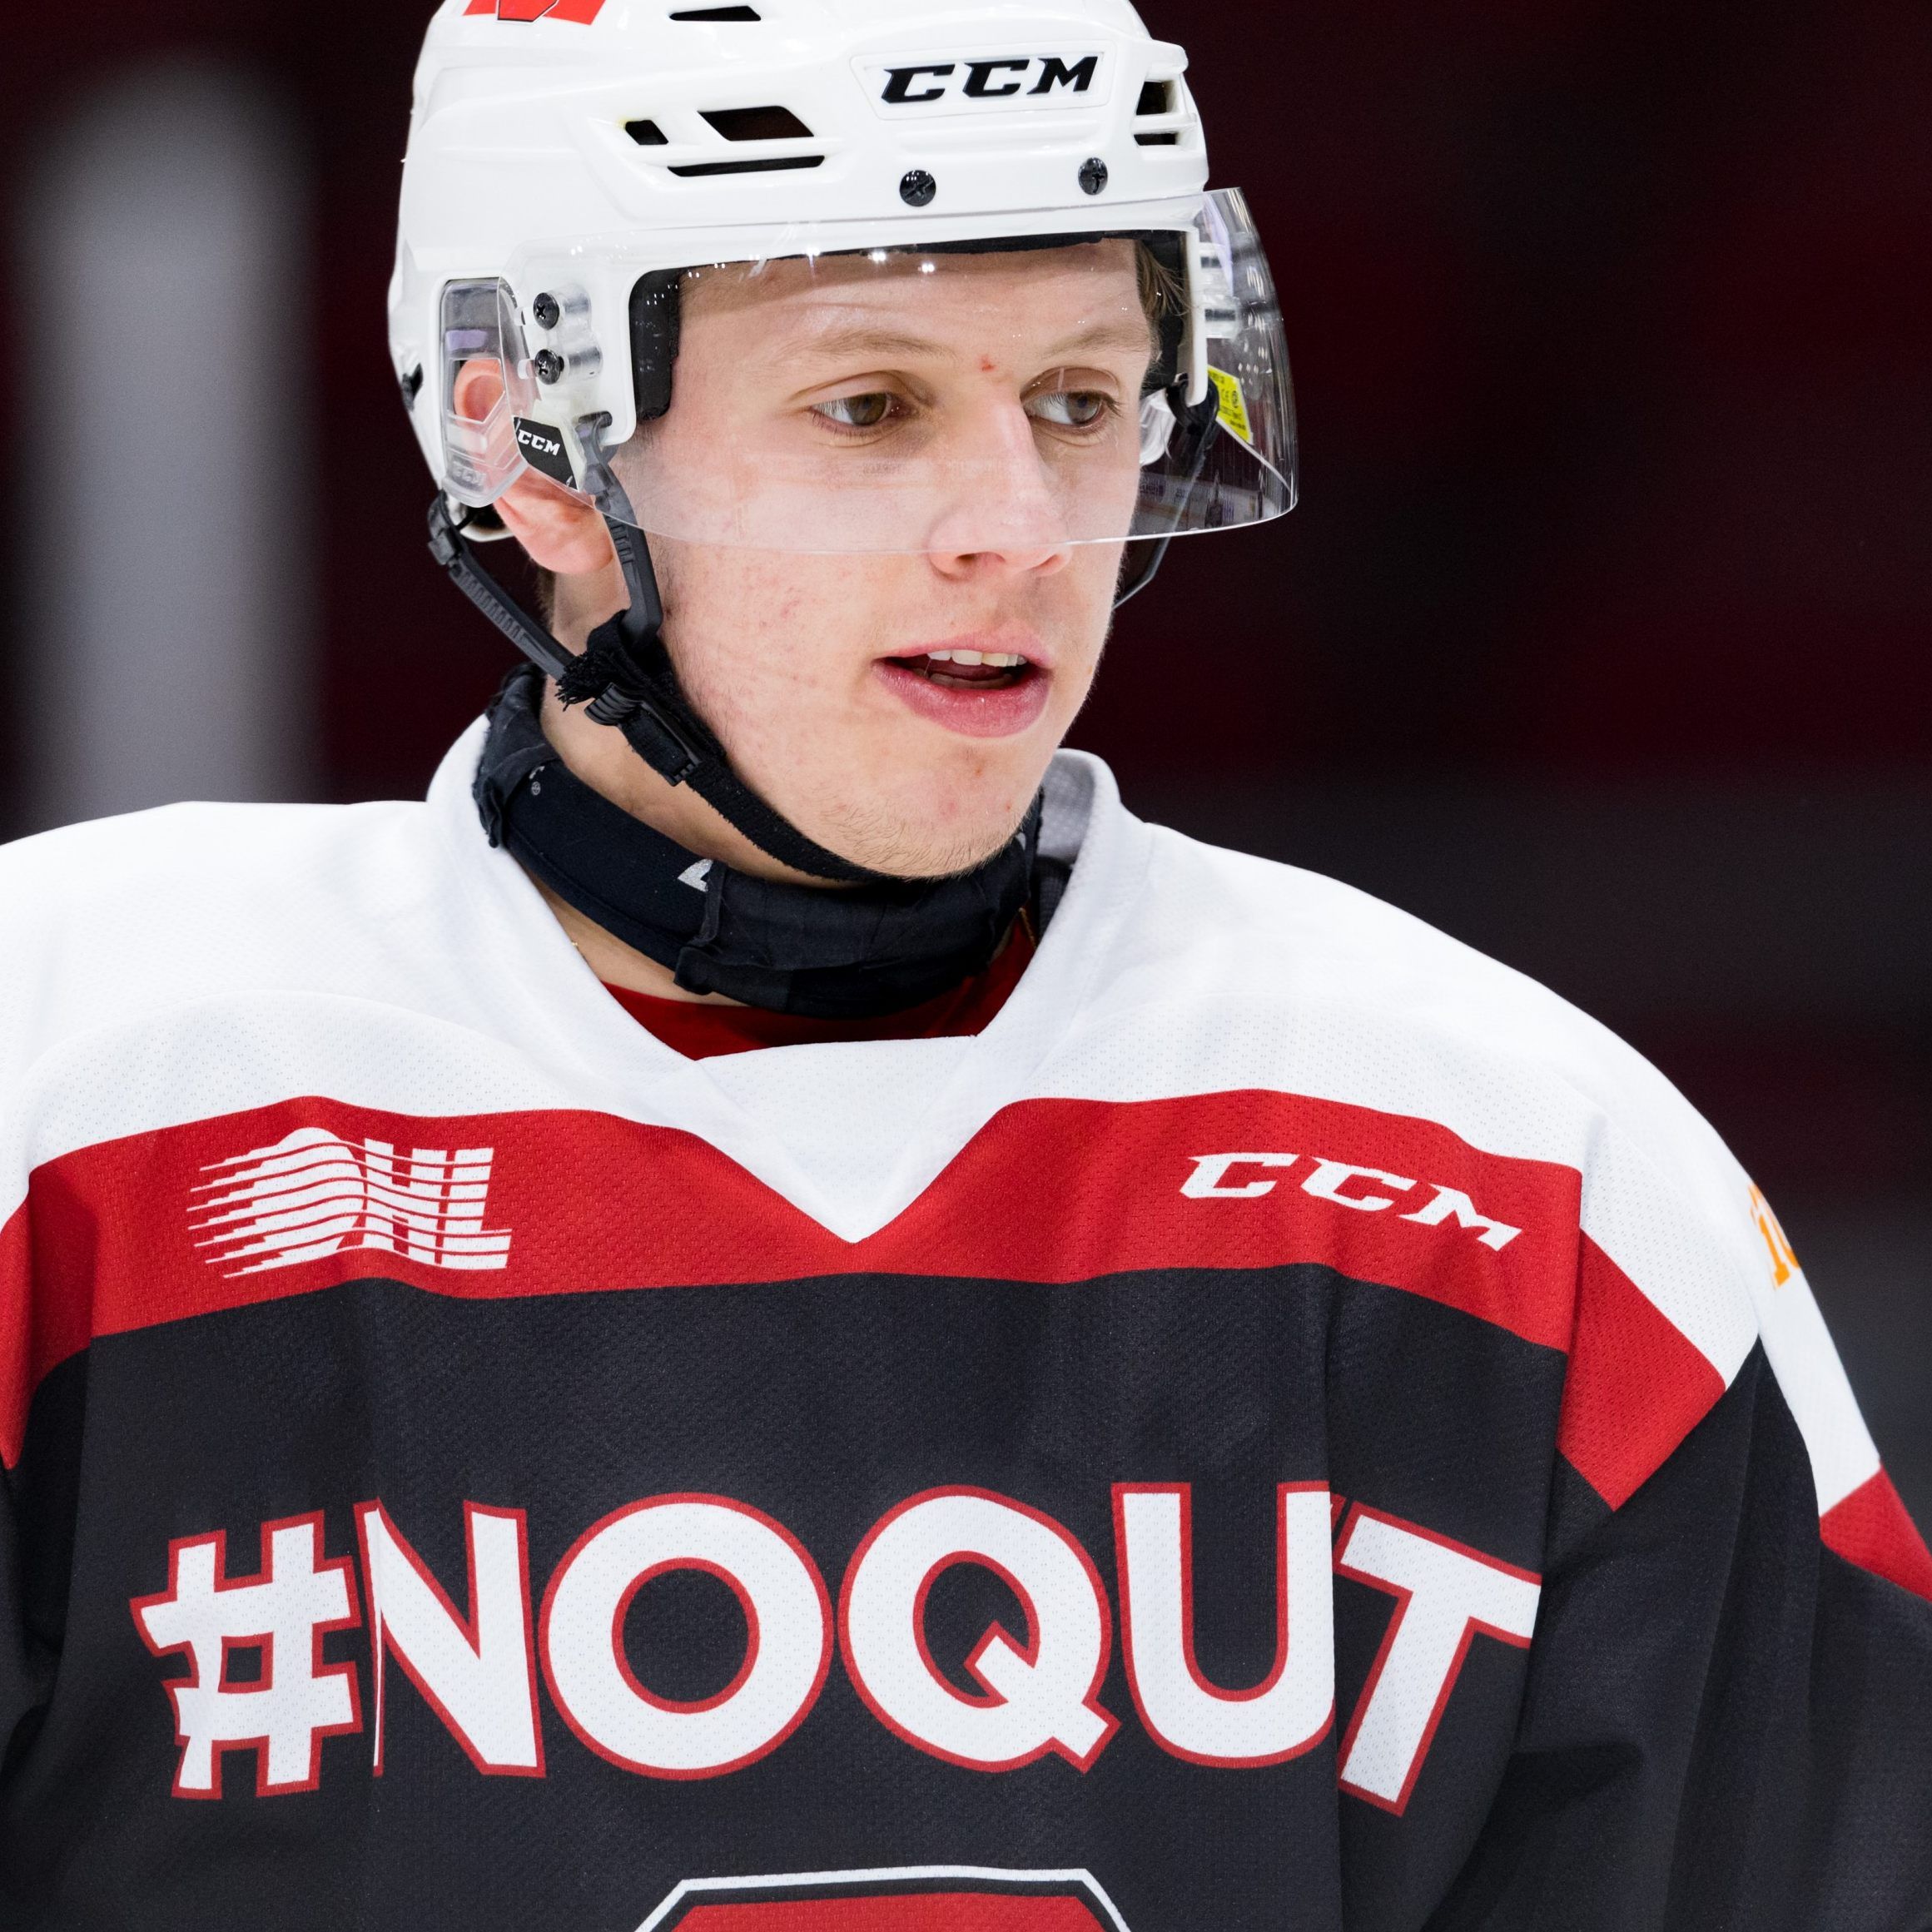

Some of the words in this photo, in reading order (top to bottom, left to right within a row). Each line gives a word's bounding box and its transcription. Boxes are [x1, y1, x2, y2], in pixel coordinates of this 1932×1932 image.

[882, 56, 1098, 103] CCM
[517, 429, 560, 455] CCM
[1180, 1152, 1522, 1252] CCM
[129, 1479, 1543, 1818] #NOQUT
